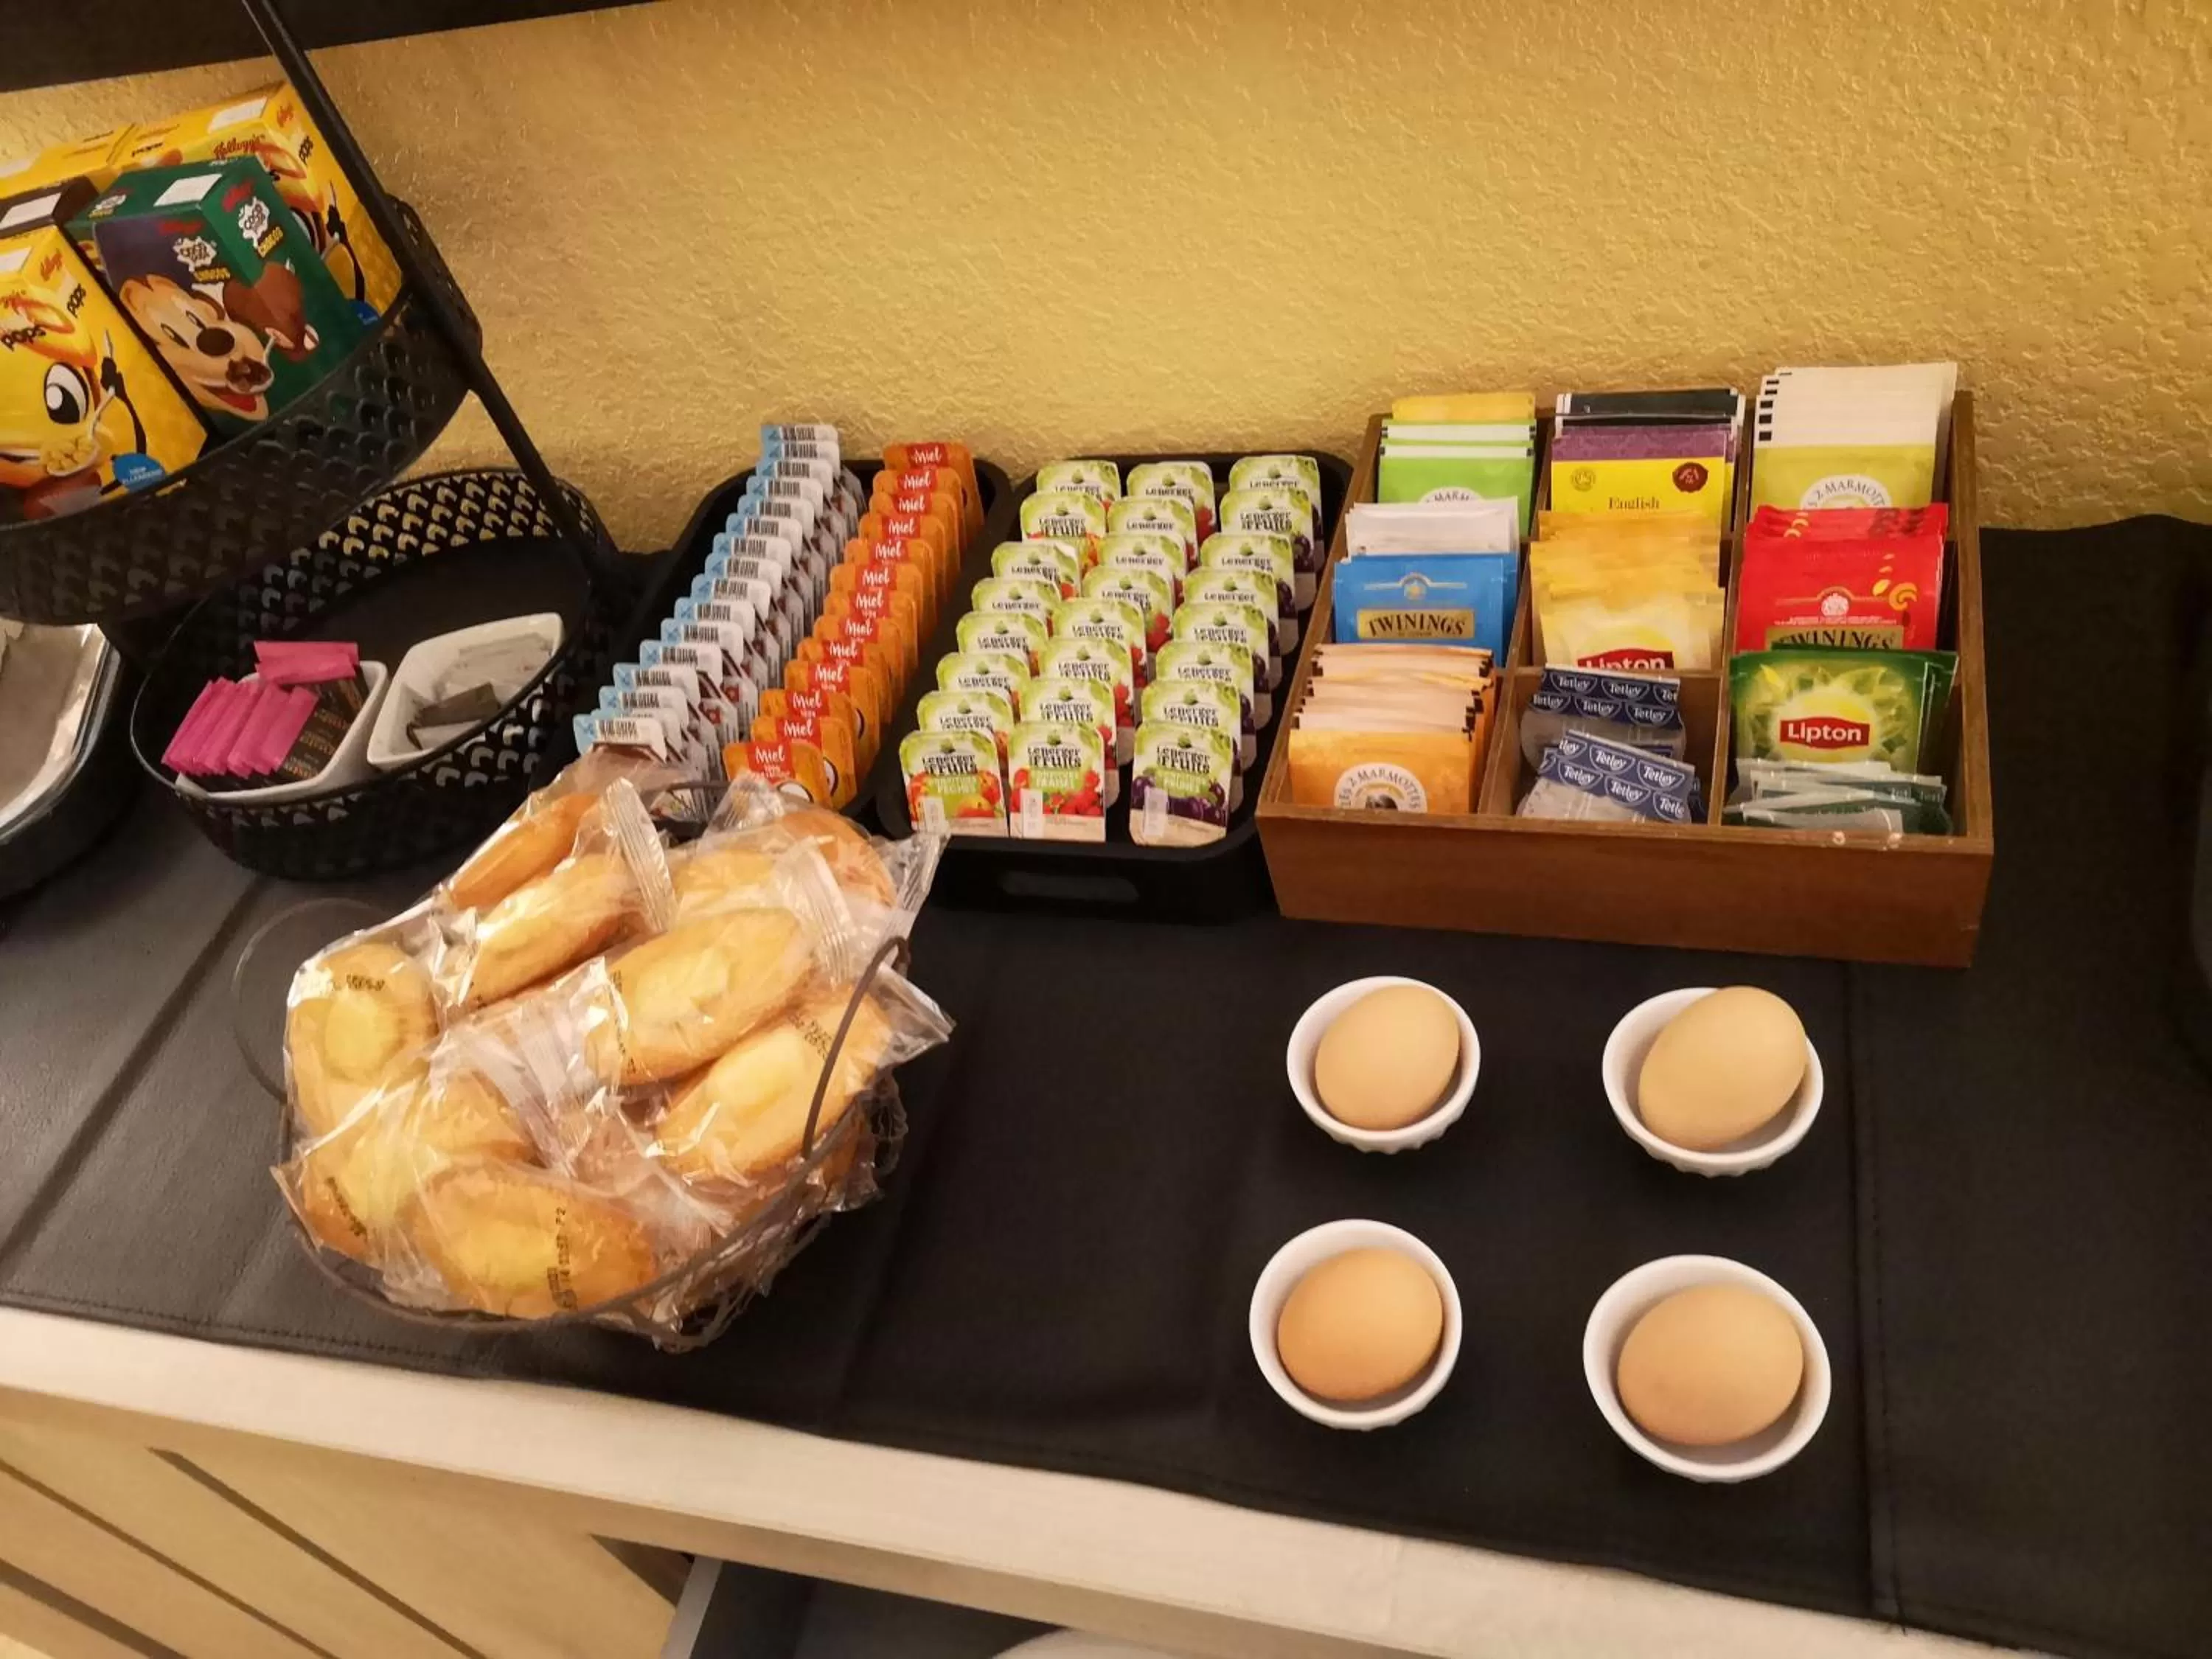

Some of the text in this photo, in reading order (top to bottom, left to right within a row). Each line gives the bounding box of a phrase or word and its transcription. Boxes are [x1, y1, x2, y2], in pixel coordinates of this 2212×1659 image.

[1, 324, 46, 351] pops
[914, 445, 942, 464] Miel
[904, 470, 931, 490] Miel
[899, 495, 925, 512] Miel
[1609, 496, 1660, 510] English
[888, 518, 916, 535] Miel
[875, 540, 902, 559] Miel
[862, 568, 890, 587] Miel
[855, 590, 884, 609] Miel
[845, 619, 872, 636] Miel
[1368, 613, 1466, 636] TWININGS
[830, 639, 858, 658] Miel
[815, 664, 844, 683] Miel
[1559, 676, 1590, 691] Tetley
[1610, 683, 1641, 699] Tetley
[793, 689, 822, 709] Miel
[1583, 700, 1614, 716] Tetley
[1634, 708, 1666, 723] Tetley
[784, 717, 813, 737] Miel
[1787, 723, 1862, 742] Lipton
[755, 745, 785, 764] Miel
[1596, 750, 1627, 770] Tetley
[1644, 765, 1675, 785] Tetley
[1564, 765, 1684, 815] Tetley Tetley Tetle
